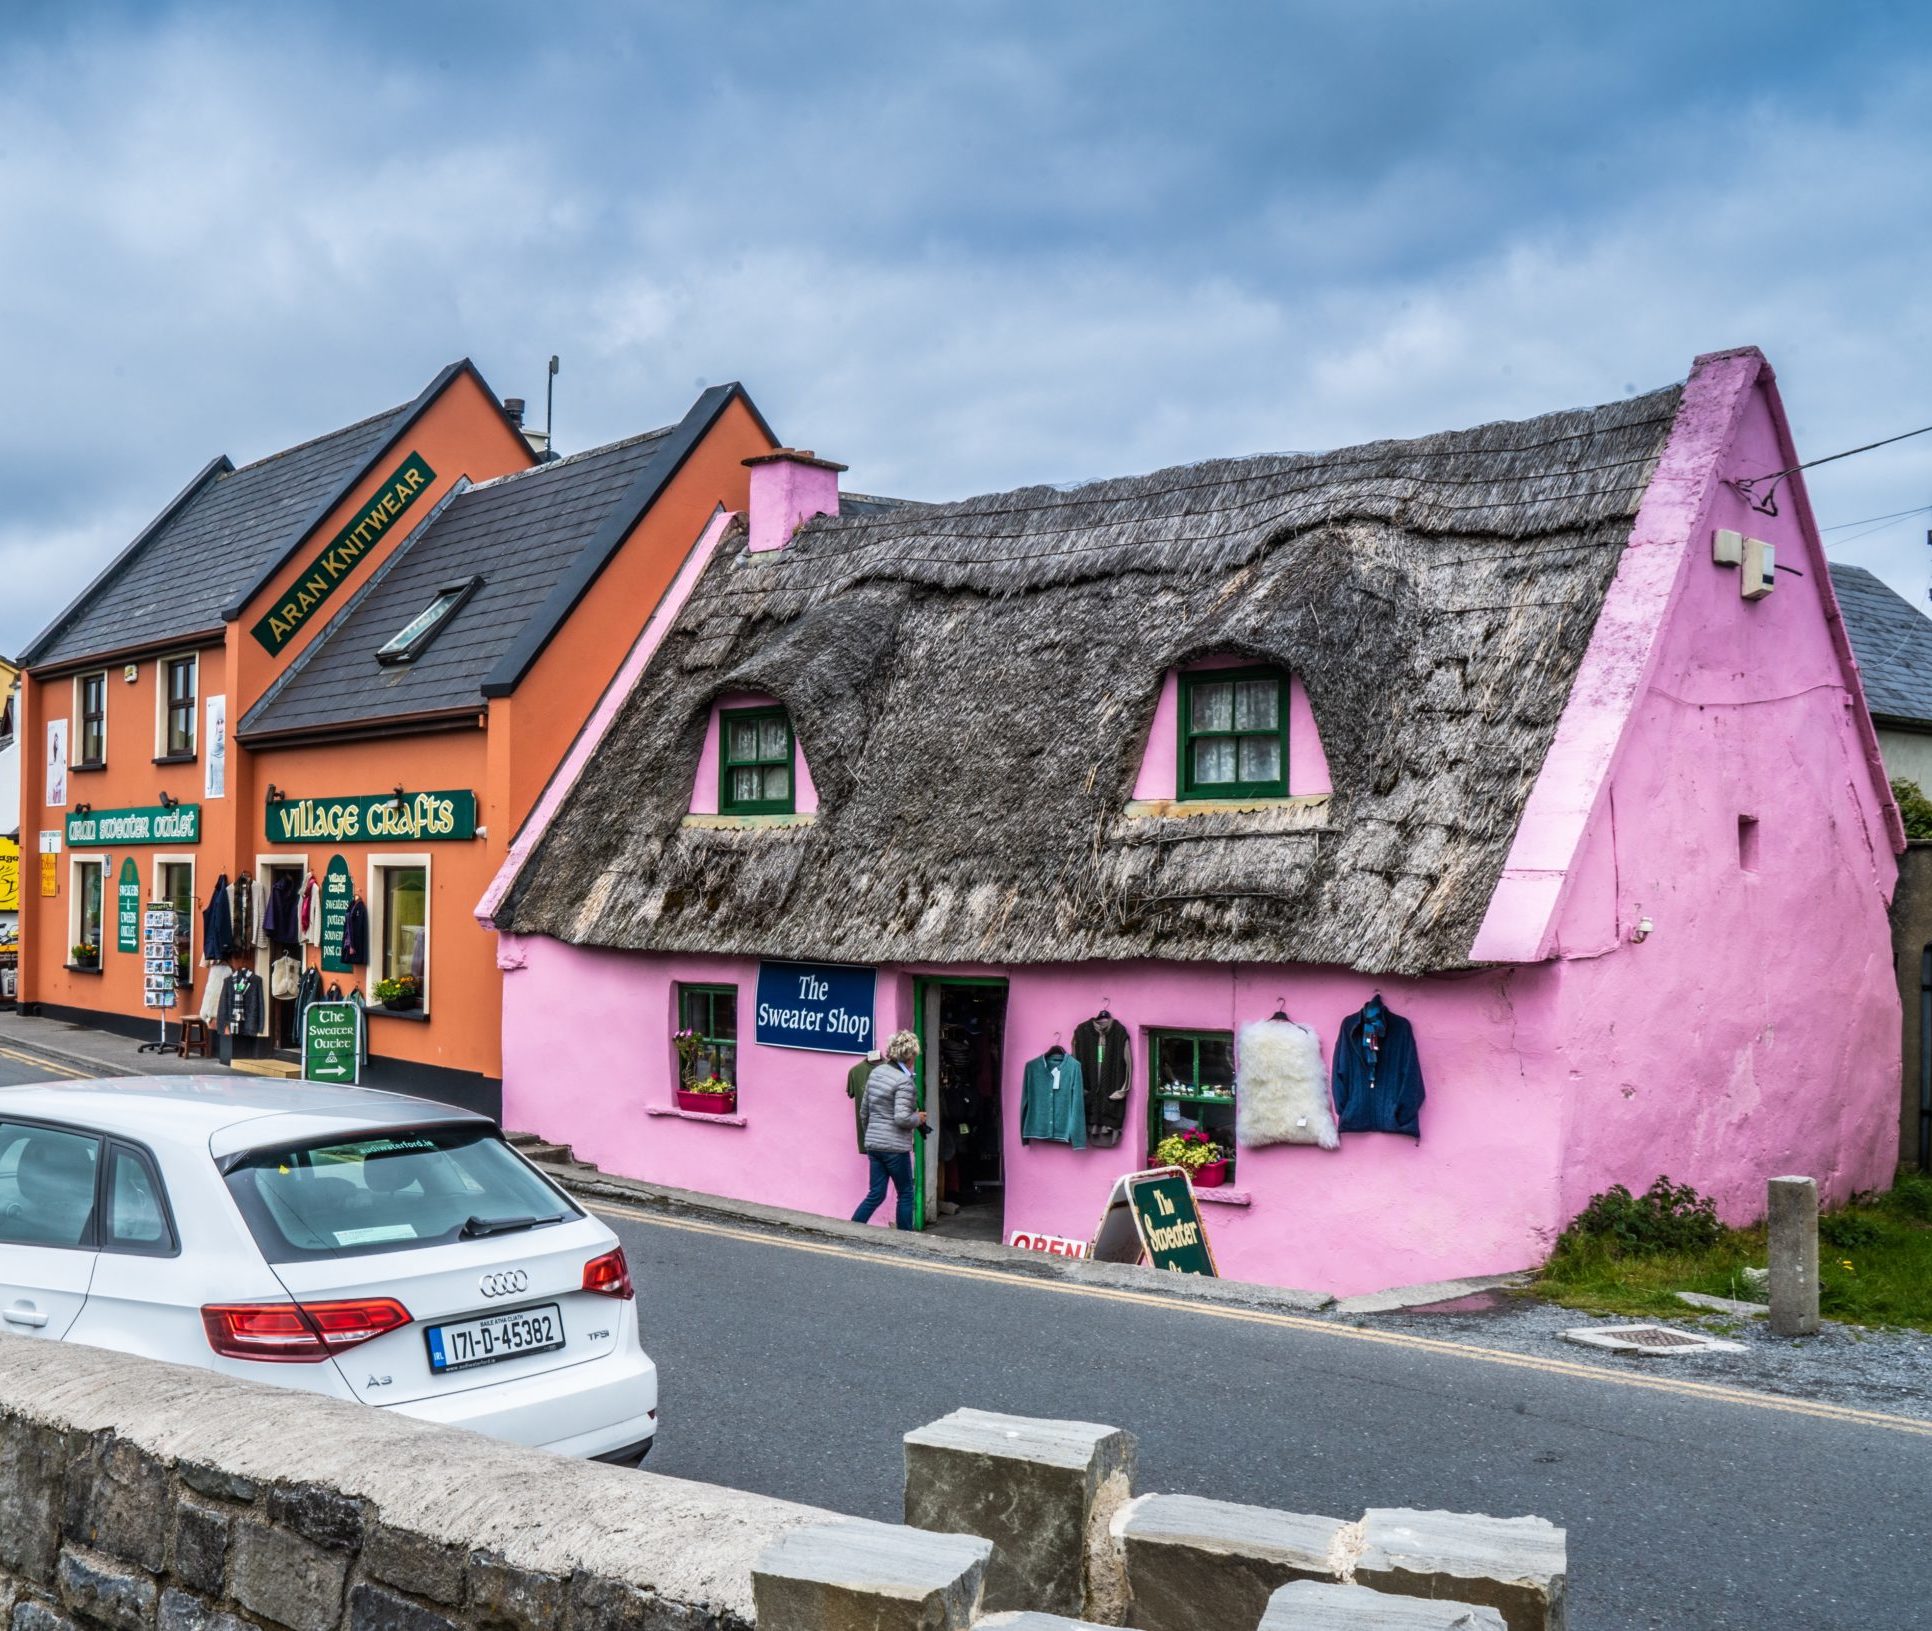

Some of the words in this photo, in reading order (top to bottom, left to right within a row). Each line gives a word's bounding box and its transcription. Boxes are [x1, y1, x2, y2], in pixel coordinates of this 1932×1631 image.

[268, 573, 329, 643] ARAN
[321, 467, 425, 579] KNITWEAR
[798, 974, 829, 1001] The
[318, 1009, 345, 1023] The
[758, 1003, 824, 1031] Sweater
[826, 1007, 870, 1043] Shop
[308, 1025, 354, 1036] Sweater
[313, 1038, 352, 1049] Outlet
[1152, 1188, 1175, 1216] The
[1144, 1213, 1198, 1252] Sweater
[451, 1315, 554, 1361] 171-D-45382
[433, 1351, 445, 1361] IRL
[366, 1373, 393, 1390] A3
